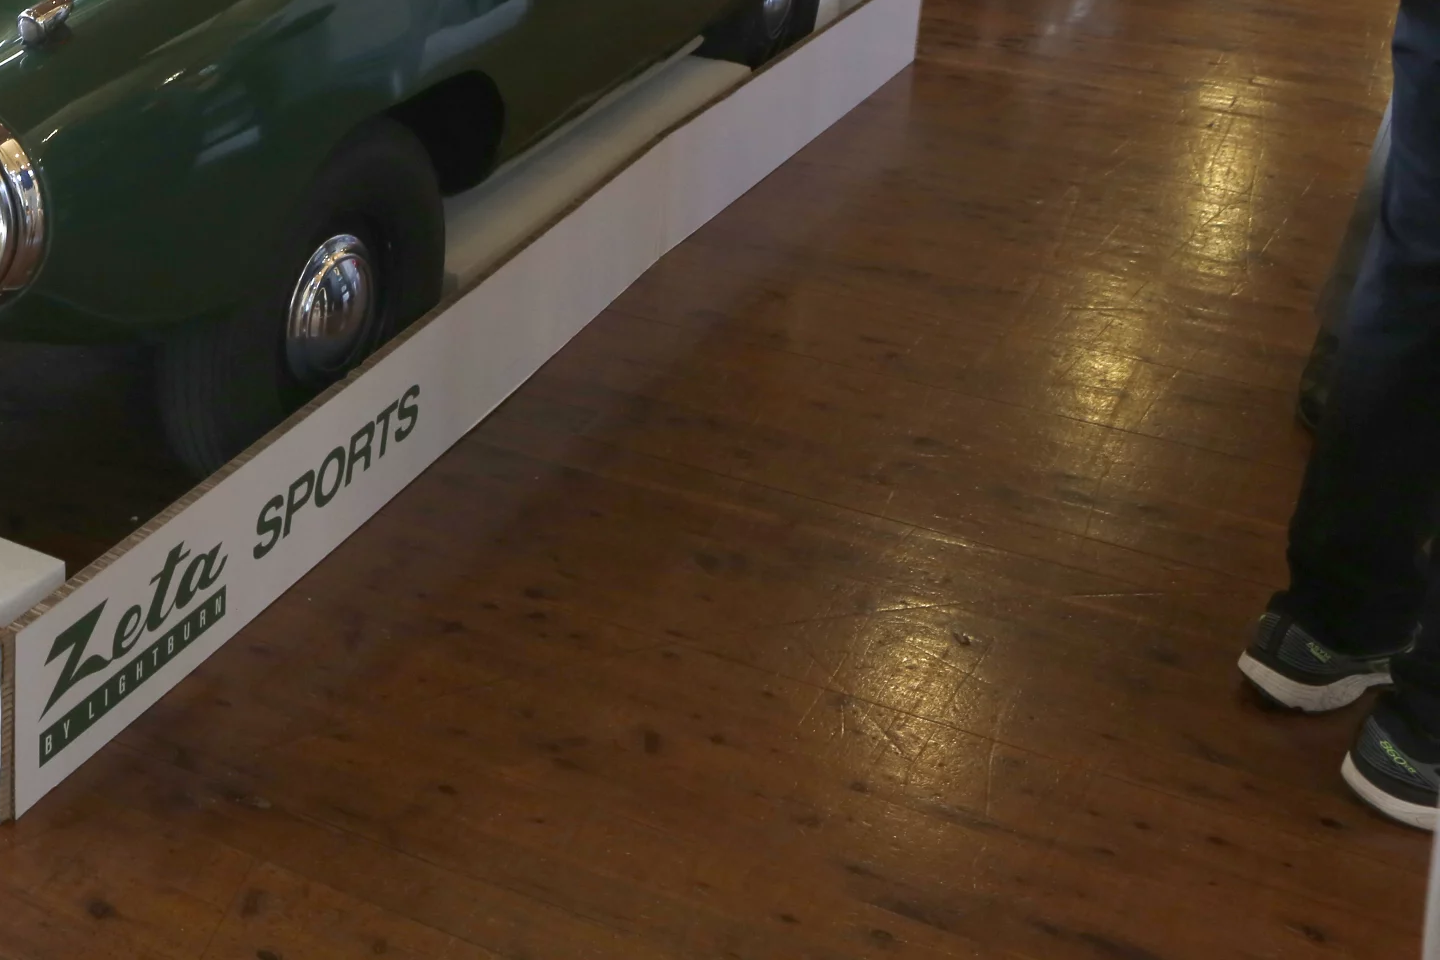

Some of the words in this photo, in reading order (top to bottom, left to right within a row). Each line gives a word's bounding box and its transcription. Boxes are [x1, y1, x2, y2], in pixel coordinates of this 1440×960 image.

[252, 384, 421, 560] SPORTS
[38, 540, 229, 723] Zeta
[45, 719, 70, 755] BY
[88, 595, 222, 719] LIGHTBURN
